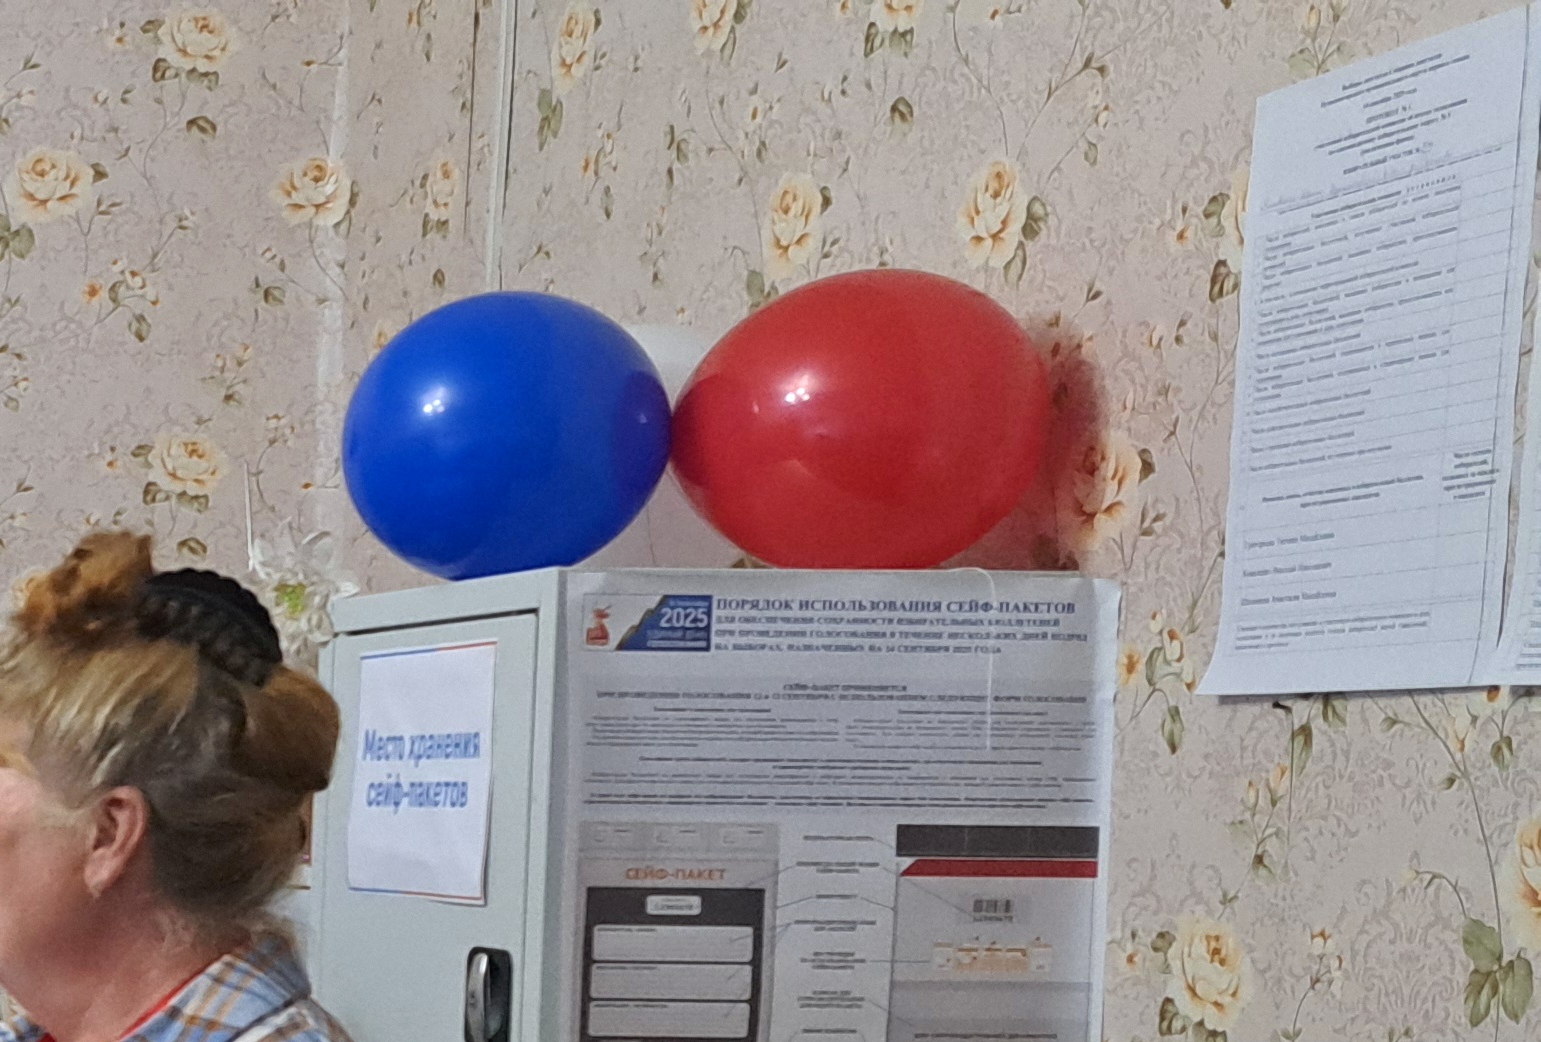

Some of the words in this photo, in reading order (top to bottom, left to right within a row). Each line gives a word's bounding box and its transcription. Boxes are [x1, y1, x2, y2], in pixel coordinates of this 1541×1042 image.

[716, 598, 793, 612] ПОРЯДОК
[798, 599, 942, 613] ИСПОЛЬЗОВАНИЯ
[946, 598, 1076, 614] СЕЙФ-ПАКЕТОВ
[659, 608, 708, 627] 2025
[362, 729, 404, 762] Место
[408, 731, 481, 768] хранения
[366, 773, 468, 815] сейф-пакетов
[626, 865, 726, 881] СЕЙФ-ПАКЕТ
